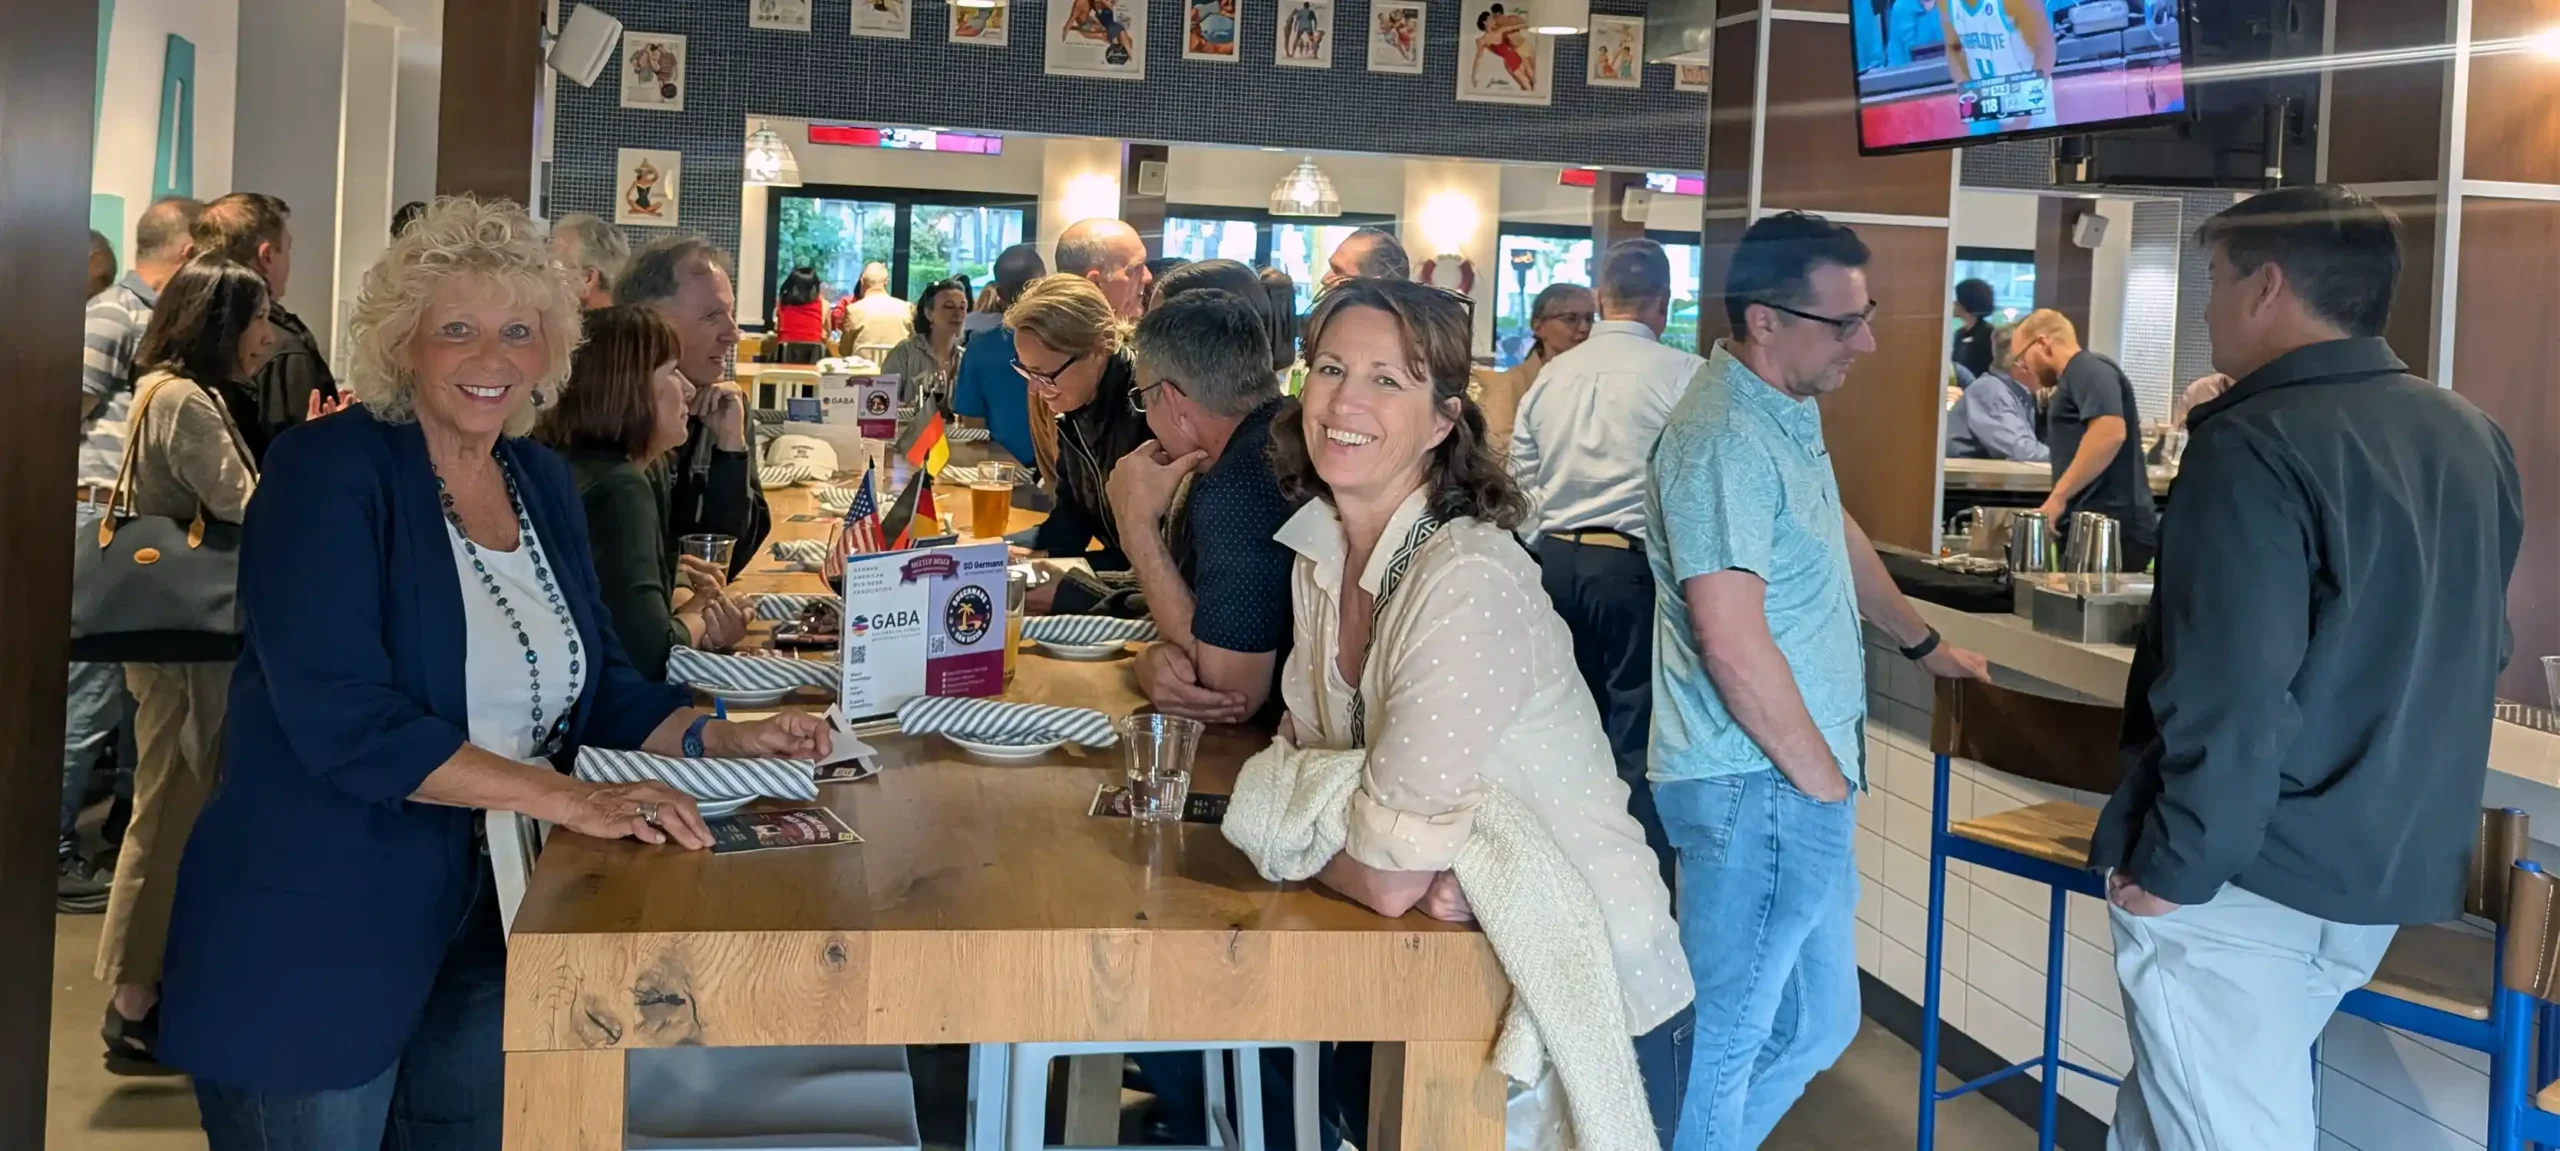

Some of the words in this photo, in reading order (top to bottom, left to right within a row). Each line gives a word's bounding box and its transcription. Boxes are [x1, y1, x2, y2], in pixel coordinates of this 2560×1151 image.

[1981, 98, 1998, 113] 118
[974, 560, 1004, 569] Germans
[872, 610, 920, 629] GABA
